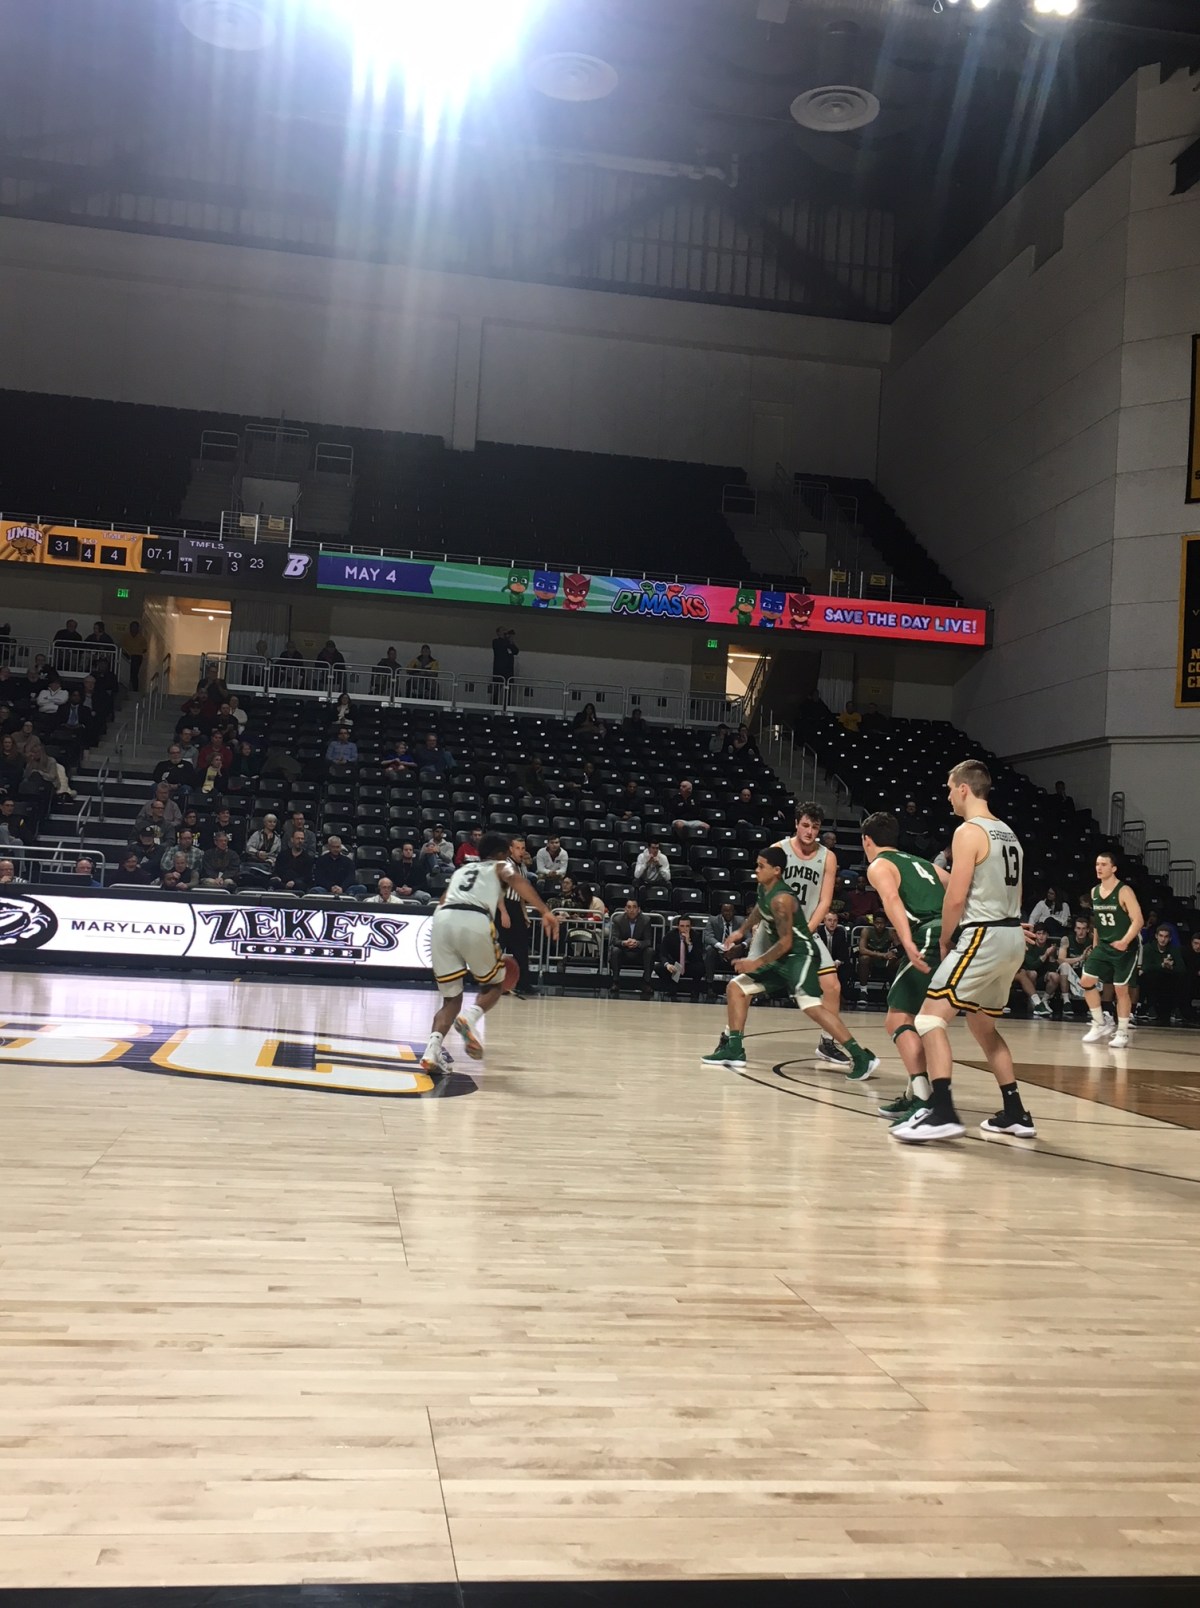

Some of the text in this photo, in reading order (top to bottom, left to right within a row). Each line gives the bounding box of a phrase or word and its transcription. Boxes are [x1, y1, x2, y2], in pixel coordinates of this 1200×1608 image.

[6, 526, 43, 545] UMBC
[55, 541, 70, 552] 31
[190, 540, 225, 550] TMFLS
[84, 549, 92, 559] 4
[110, 550, 118, 560] 4
[147, 547, 173, 561] 07.1
[226, 551, 243, 559] TO
[183, 562, 189, 572] 1
[205, 560, 213, 571] 7
[231, 561, 239, 572] 3
[250, 558, 264, 569] 23
[282, 552, 312, 579] B
[345, 565, 397, 583] MAY 4
[117, 588, 129, 598] EXIT
[824, 608, 978, 634] SAVE THE DAY LIVE!
[707, 639, 718, 648] EXIT
[1002, 845, 1019, 886] 13
[783, 865, 820, 885] UMBC
[912, 861, 936, 885] 4
[458, 869, 480, 892] 3
[1098, 912, 1116, 926] 33
[71, 920, 186, 936] MARYLAND
[198, 907, 409, 951] ZEKE'S
[245, 945, 354, 957] COFFEE
